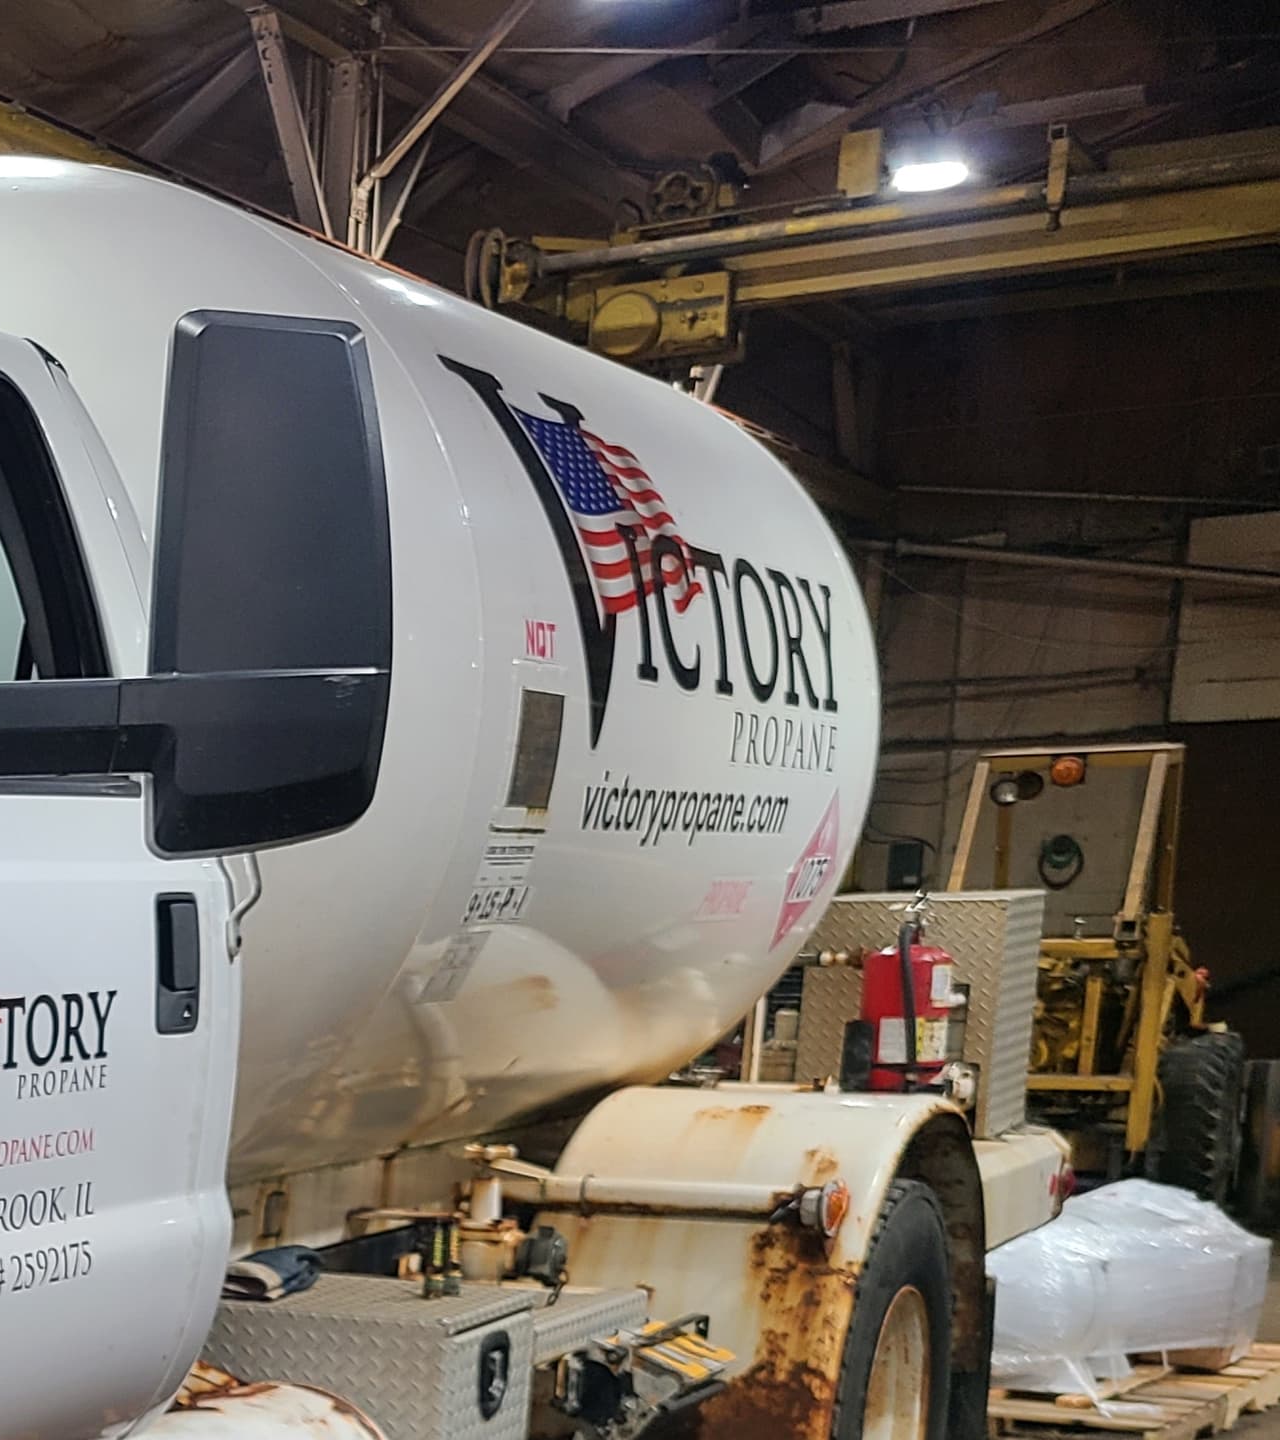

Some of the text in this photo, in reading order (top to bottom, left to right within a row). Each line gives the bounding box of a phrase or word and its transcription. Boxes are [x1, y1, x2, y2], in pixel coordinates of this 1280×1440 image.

[436, 354, 839, 751] VICTORY
[730, 711, 839, 774] PROPANE
[580, 771, 790, 846] victorypropane.com
[17, 1066, 109, 1101] PROPANE
[75, 1181, 95, 1218] IL
